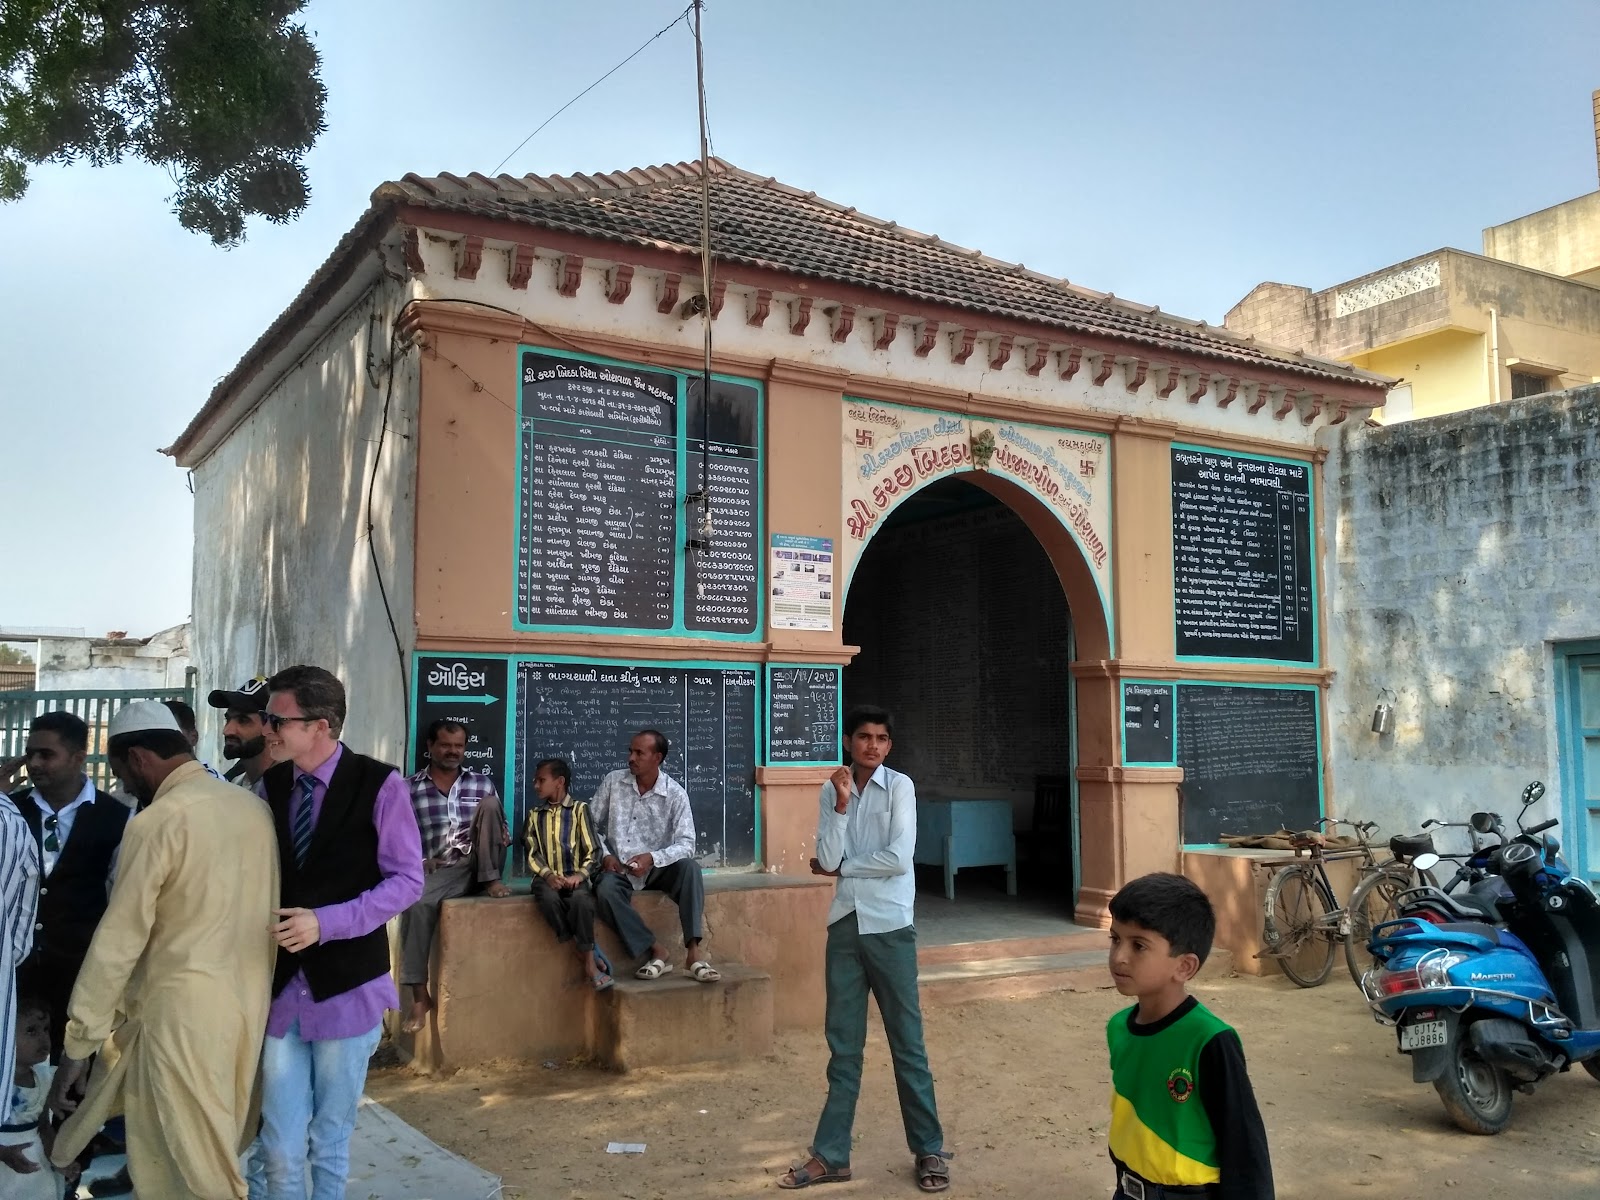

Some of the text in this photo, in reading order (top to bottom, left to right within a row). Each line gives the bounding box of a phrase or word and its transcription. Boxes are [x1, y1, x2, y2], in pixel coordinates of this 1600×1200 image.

[524, 368, 536, 382] શ્રી
[1220, 457, 1233, 468] અને
[1289, 467, 1303, 478] માટે
[847, 499, 878, 540] શ્રી
[549, 669, 597, 682] ભાગ્યશાળી
[1414, 1022, 1436, 1035] GJ12
[1409, 1033, 1444, 1047] CJ8886
